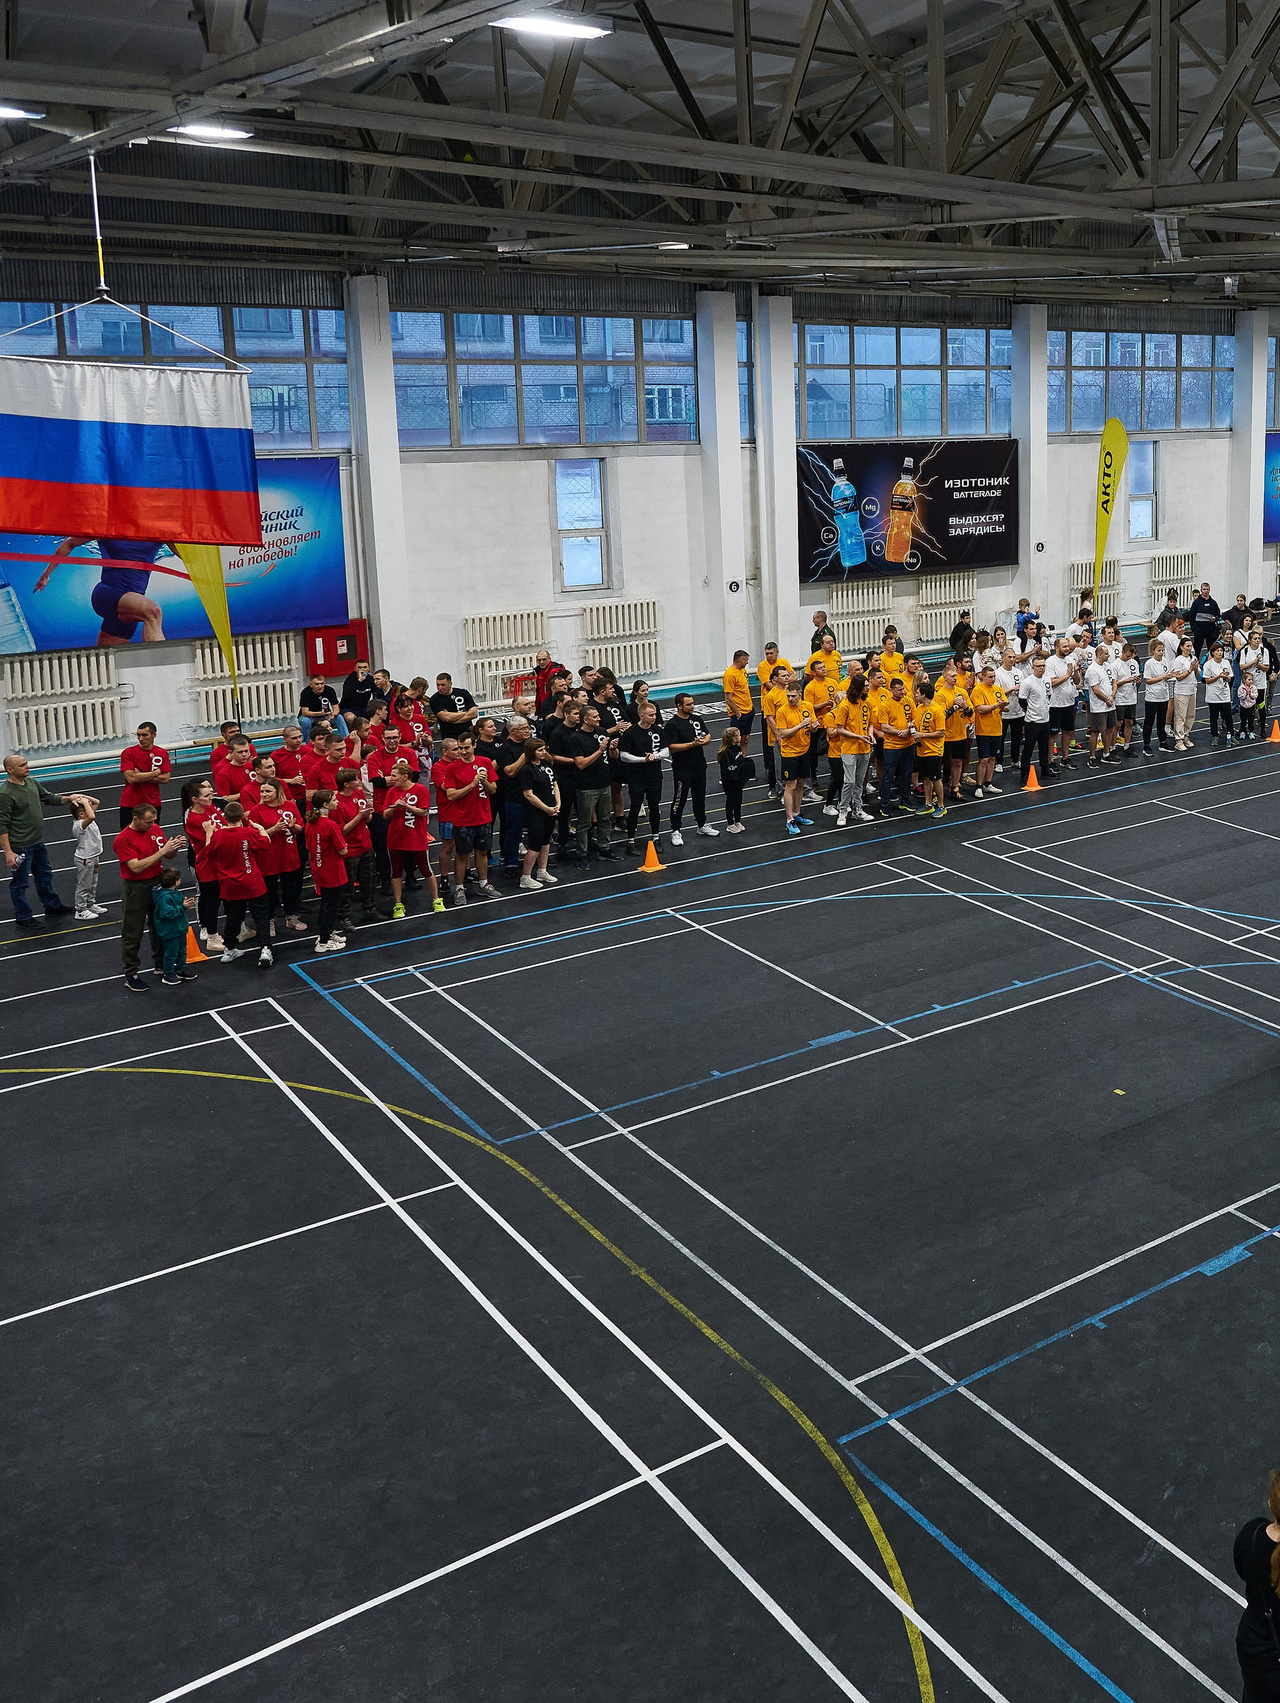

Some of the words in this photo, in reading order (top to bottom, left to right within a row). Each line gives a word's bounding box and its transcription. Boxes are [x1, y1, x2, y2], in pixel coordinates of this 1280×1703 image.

[944, 476, 1010, 489] ИЗОТОНИК
[953, 489, 1003, 499] BATTERADE
[260, 505, 304, 522] йский
[865, 504, 877, 512] Mg
[949, 514, 1005, 525] ВЫДОХСЯ?
[261, 519, 301, 534] чник
[948, 525, 1006, 537] ЗАРЯДИСЬ!
[228, 560, 244, 570] на
[248, 545, 298, 566] победы!
